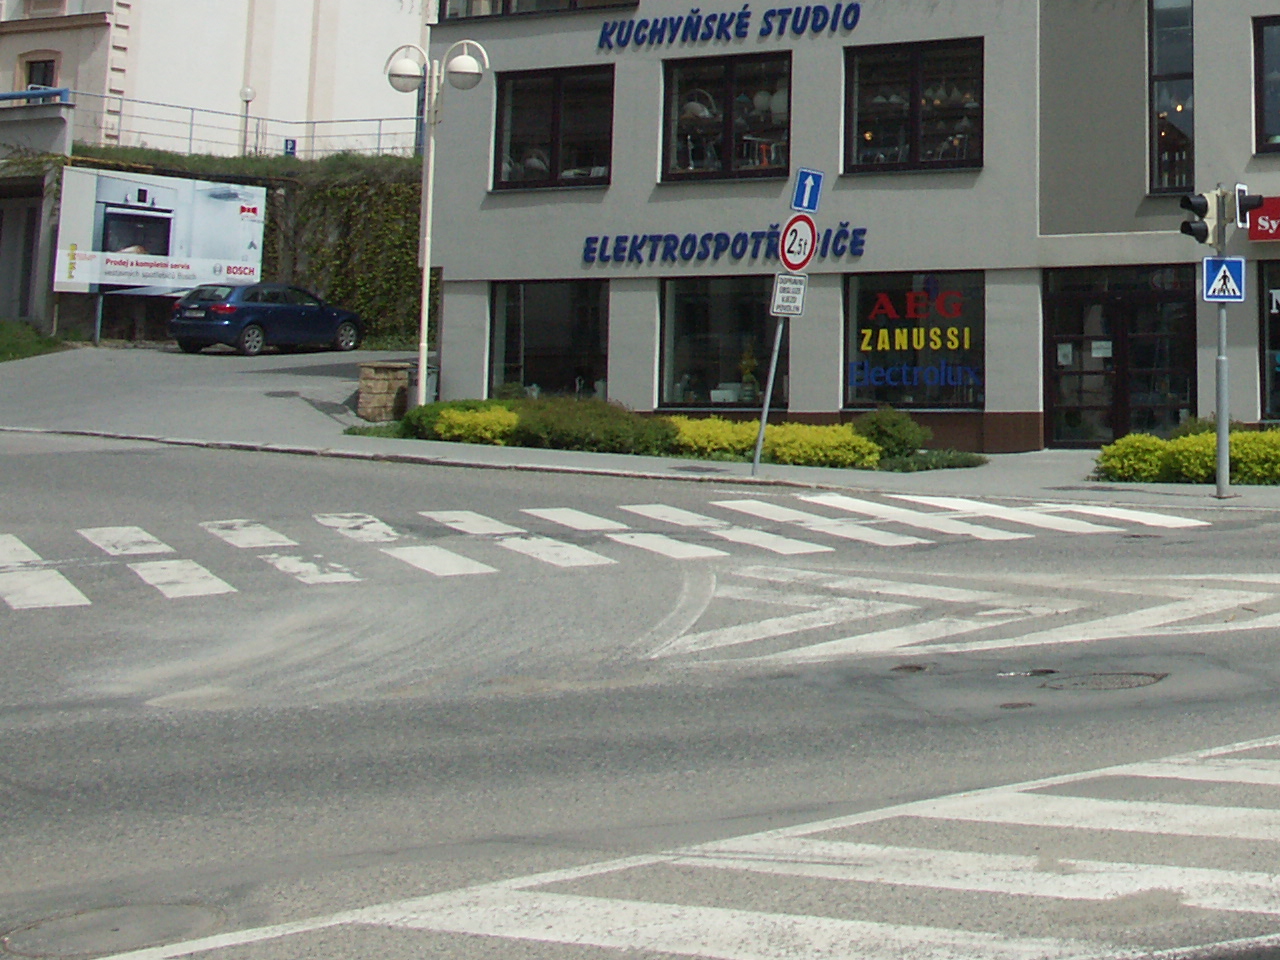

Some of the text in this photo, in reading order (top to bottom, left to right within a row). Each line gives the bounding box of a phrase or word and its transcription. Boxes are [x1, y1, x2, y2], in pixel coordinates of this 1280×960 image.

[598, 2, 861, 50] KUCHYŇSKÉ STUDIO
[583, 221, 868, 264] ELEKTROSPOTŘIČE
[226, 265, 255, 276] BOSCH
[868, 290, 964, 320] AEG
[860, 326, 971, 351] ZANUSSI
[848, 359, 982, 387] Electrolux
